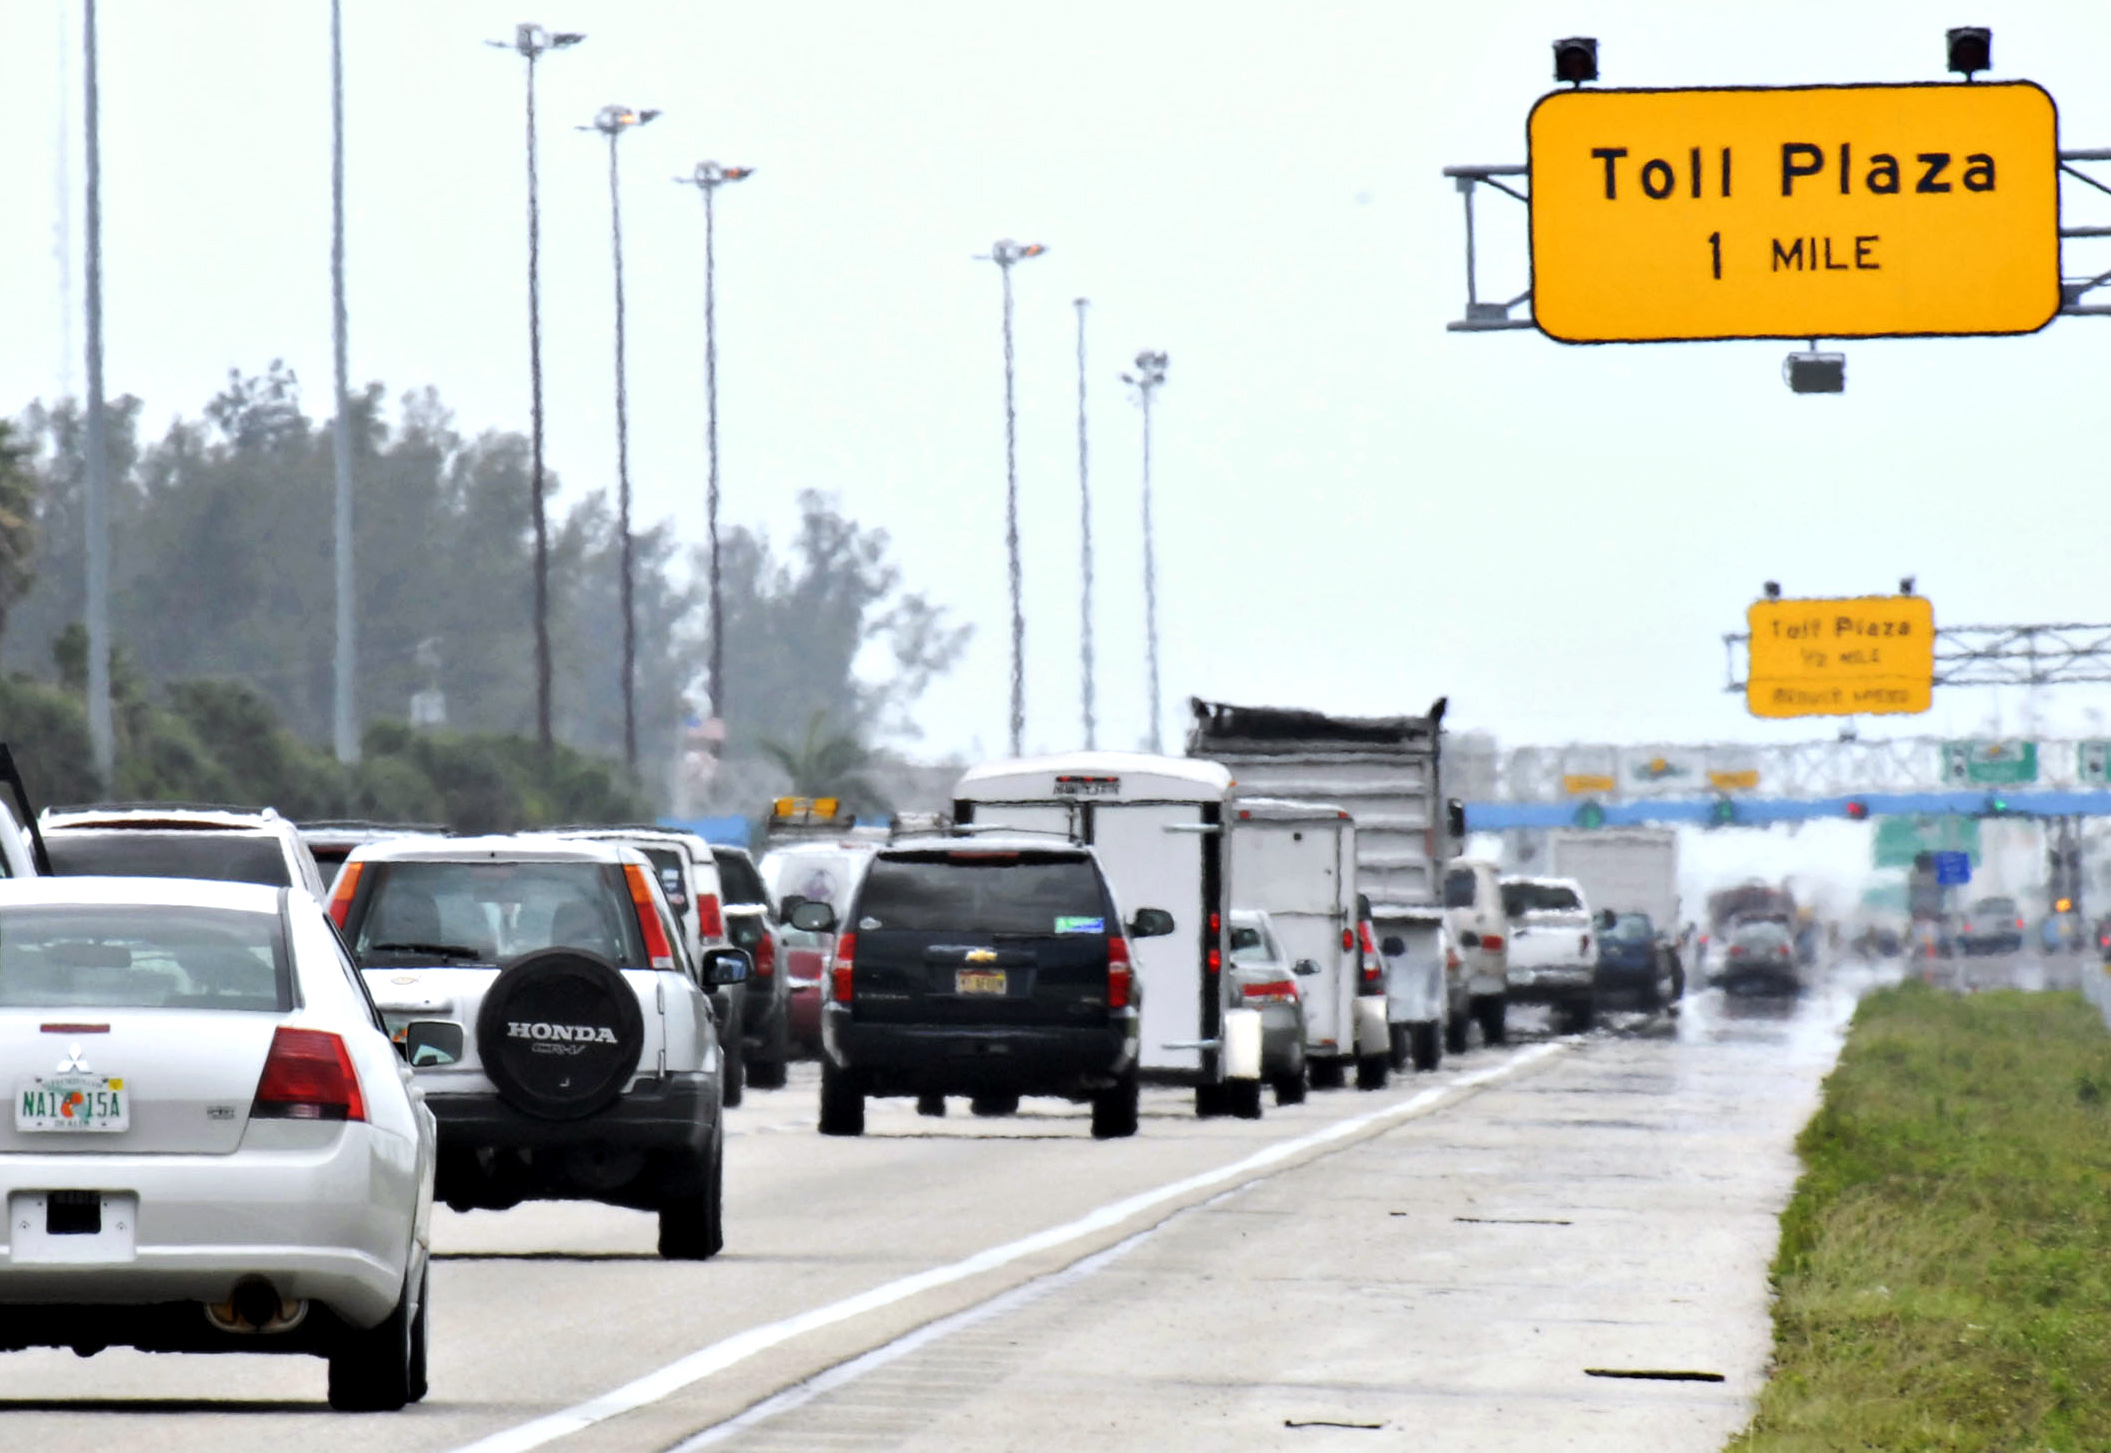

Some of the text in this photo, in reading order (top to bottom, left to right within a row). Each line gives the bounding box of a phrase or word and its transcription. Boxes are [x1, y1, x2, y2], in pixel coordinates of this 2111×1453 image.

[1591, 142, 1996, 200] Toll Plaza
[1709, 231, 1880, 280] 1 MILE
[1771, 616, 1911, 639] Toll Plaza
[506, 1021, 618, 1044] HONDA
